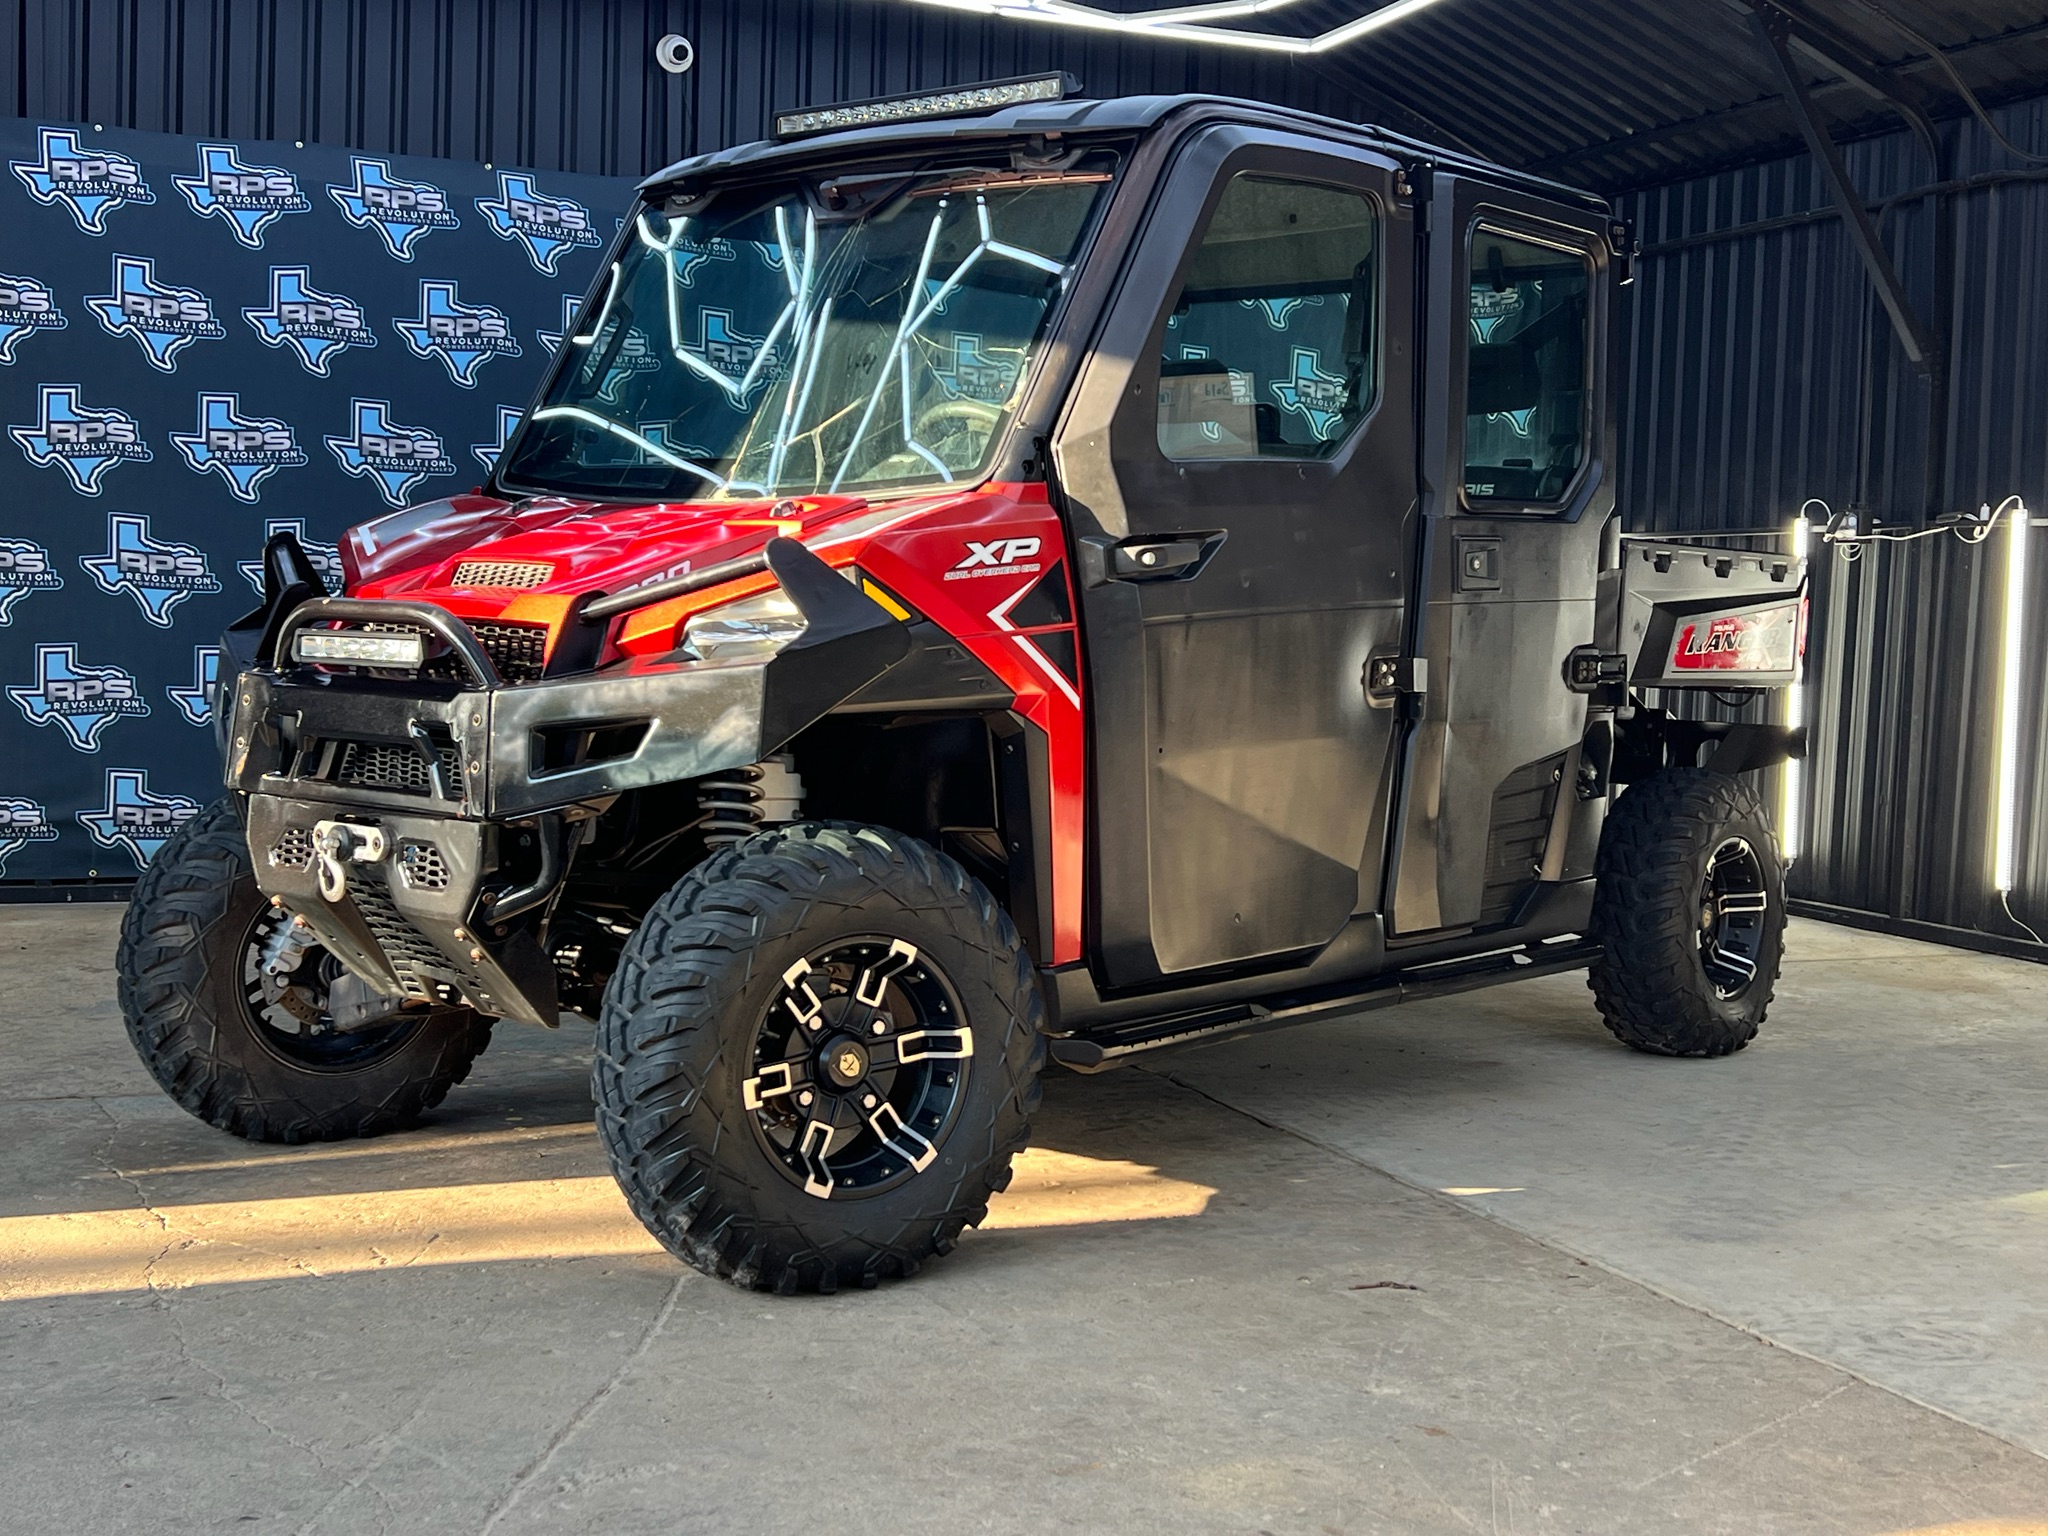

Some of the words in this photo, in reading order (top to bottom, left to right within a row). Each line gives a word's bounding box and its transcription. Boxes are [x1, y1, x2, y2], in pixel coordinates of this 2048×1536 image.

[51, 160, 138, 185] RPS
[58, 181, 146, 195] REVOLUTION
[211, 174, 295, 197] RPS
[217, 194, 301, 205] REVOLUTION
[363, 186, 444, 212] RPS
[370, 206, 450, 221] REVOLUTION
[510, 200, 586, 230] RPS
[516, 220, 592, 239] REVOLUTION
[124, 294, 209, 322] RPS
[281, 303, 361, 329] RPS
[130, 315, 216, 330] REVOLUTION
[286, 323, 367, 339] REVOLUTION
[429, 317, 507, 338] RPS
[435, 337, 512, 348] REVOLUTION
[50, 421, 136, 445] RPS
[209, 429, 291, 451] RPS
[55, 442, 142, 454] REVOLUTION
[215, 450, 298, 460] REVOLUTION
[362, 436, 440, 460] RPS
[367, 456, 447, 468] REVOLUTION
[120, 551, 204, 575] RPS
[954, 537, 1042, 569] XP
[125, 572, 212, 585] REVOLUTION
[47, 679, 133, 701] RPS
[54, 699, 140, 710] REVOLUTION
